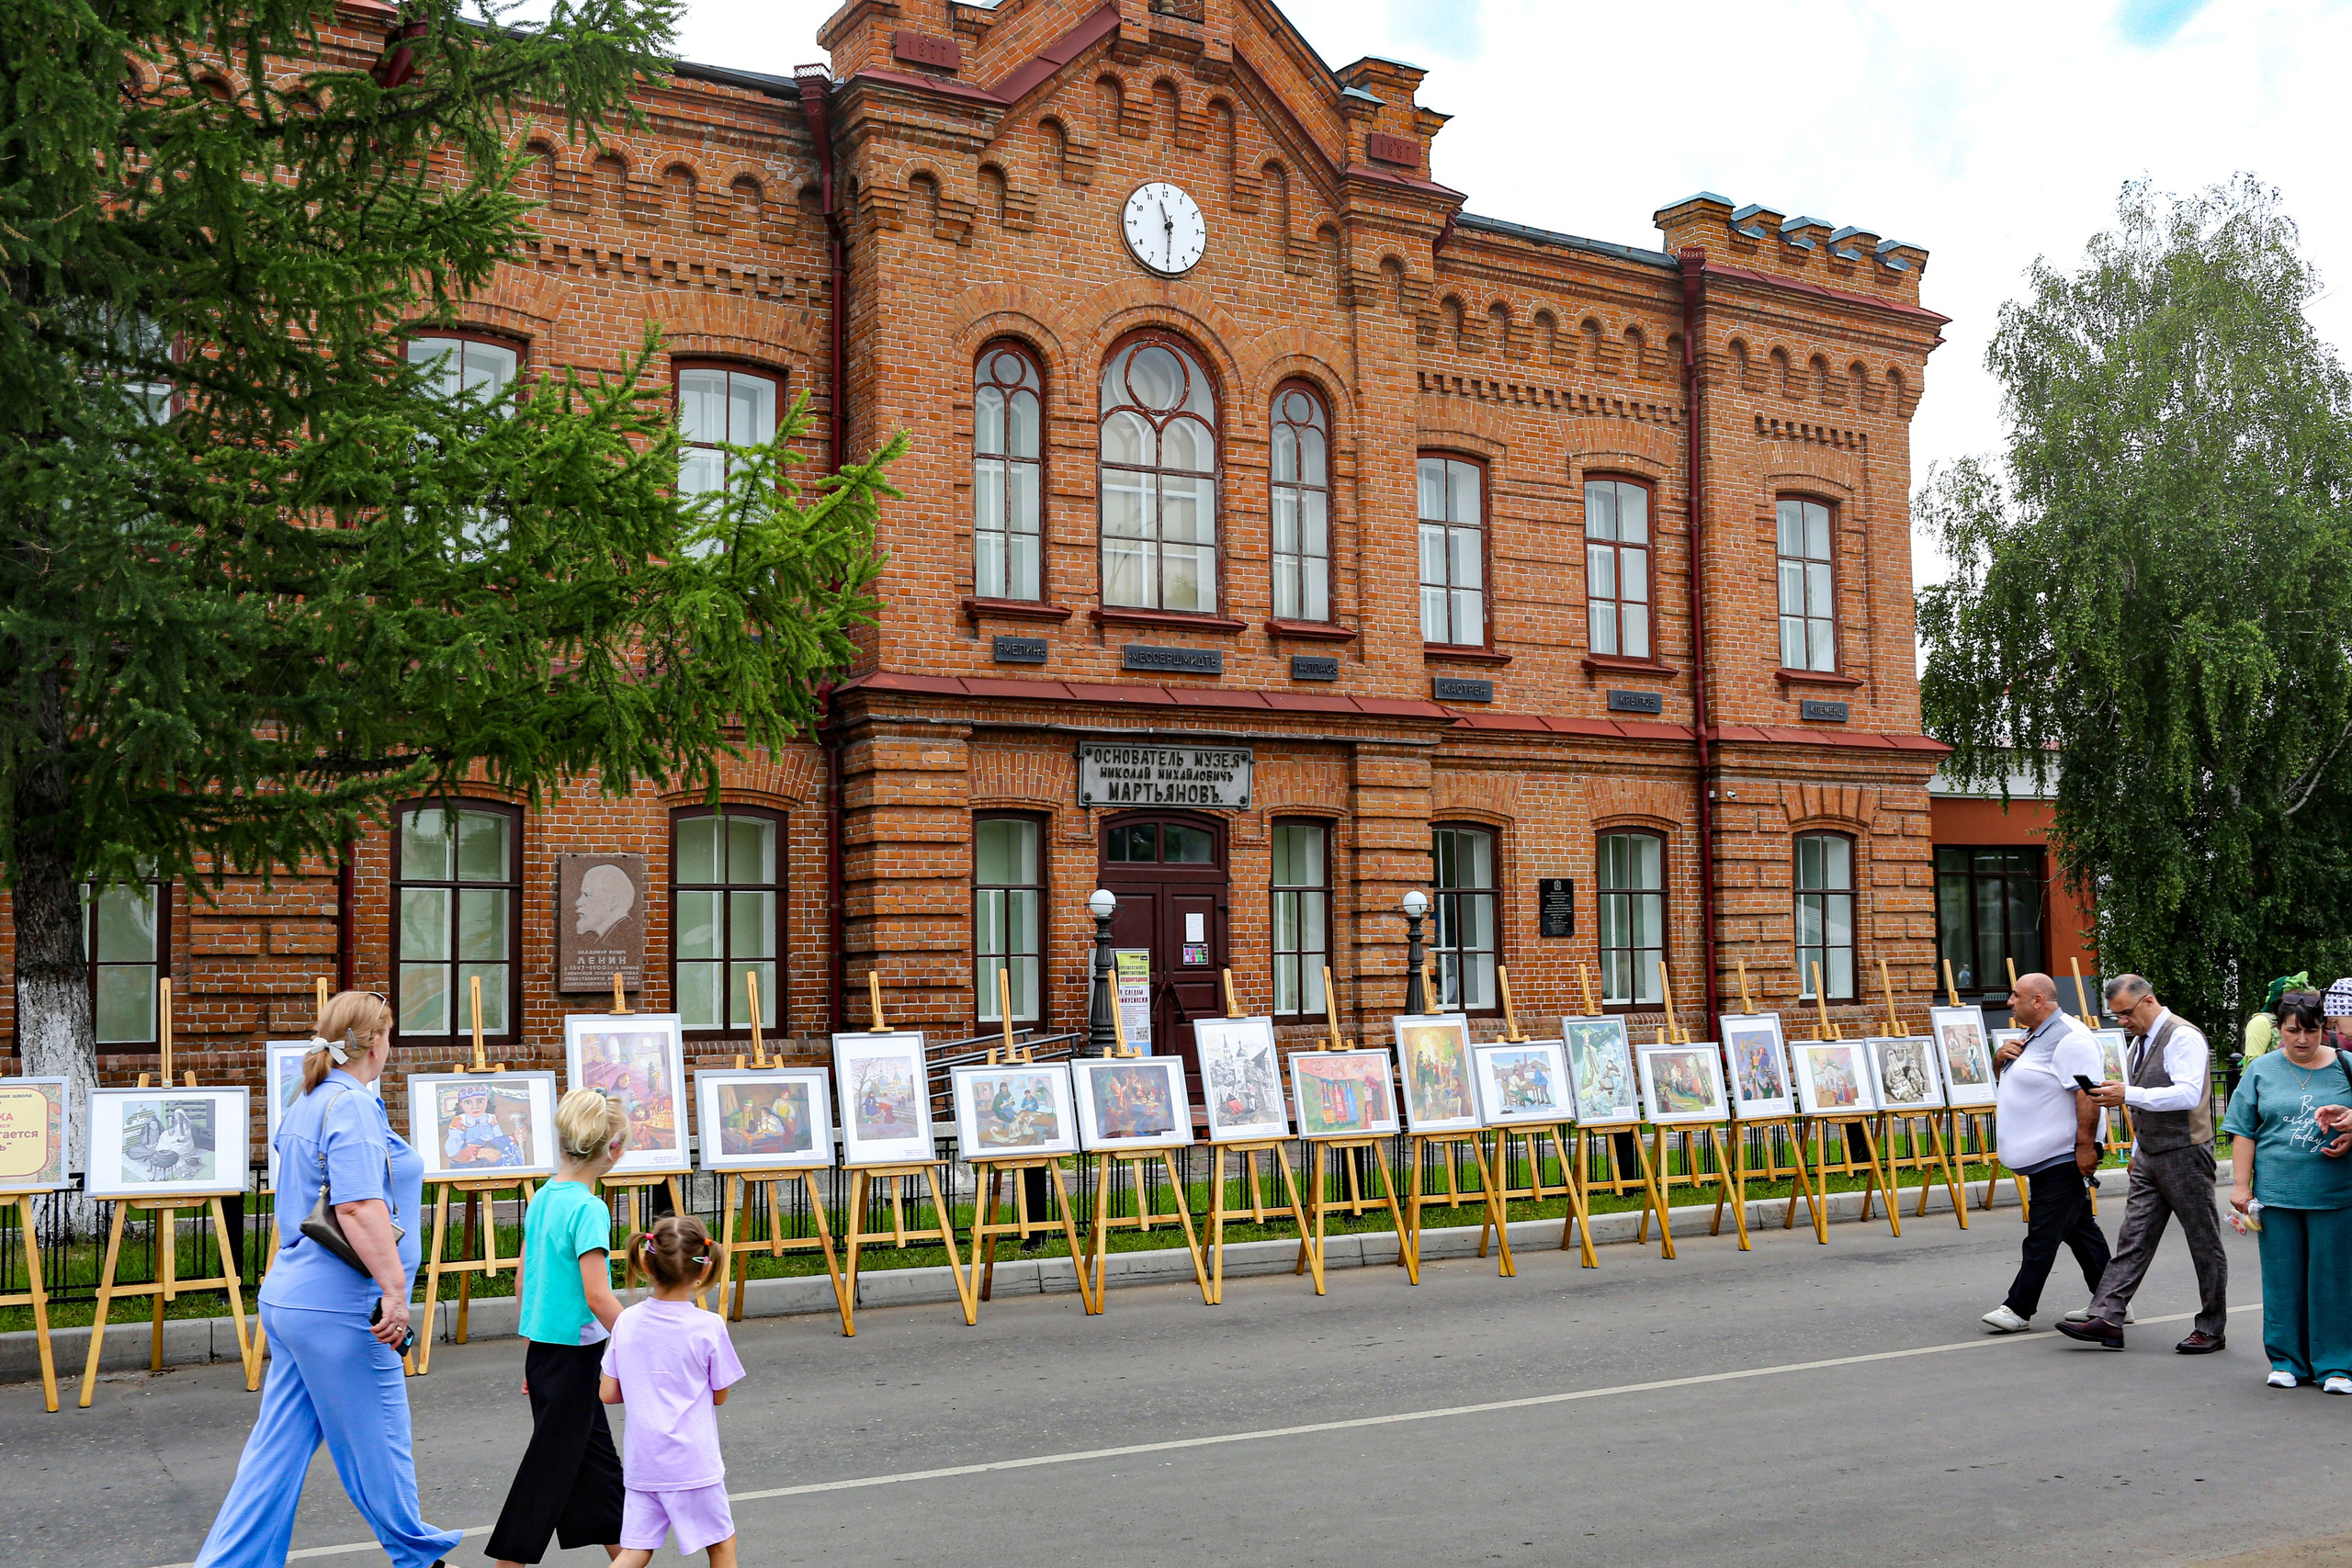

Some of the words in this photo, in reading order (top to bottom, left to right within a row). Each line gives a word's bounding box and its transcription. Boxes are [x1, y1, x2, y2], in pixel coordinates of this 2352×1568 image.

[909, 40, 946, 62] 1877
[1444, 683, 1487, 695] КАСТРЕН
[1094, 748, 1184, 767] ОСНОВАТЕЛЬ
[1194, 751, 1240, 769] МУЗЕЯ
[1101, 766, 1151, 779] НИКОЛАЙ
[1158, 768, 1234, 783] МИХАЙЛОВИЧЪ
[577, 956, 627, 964] ЛЕНИН
[2300, 1095, 2316, 1120] Be
